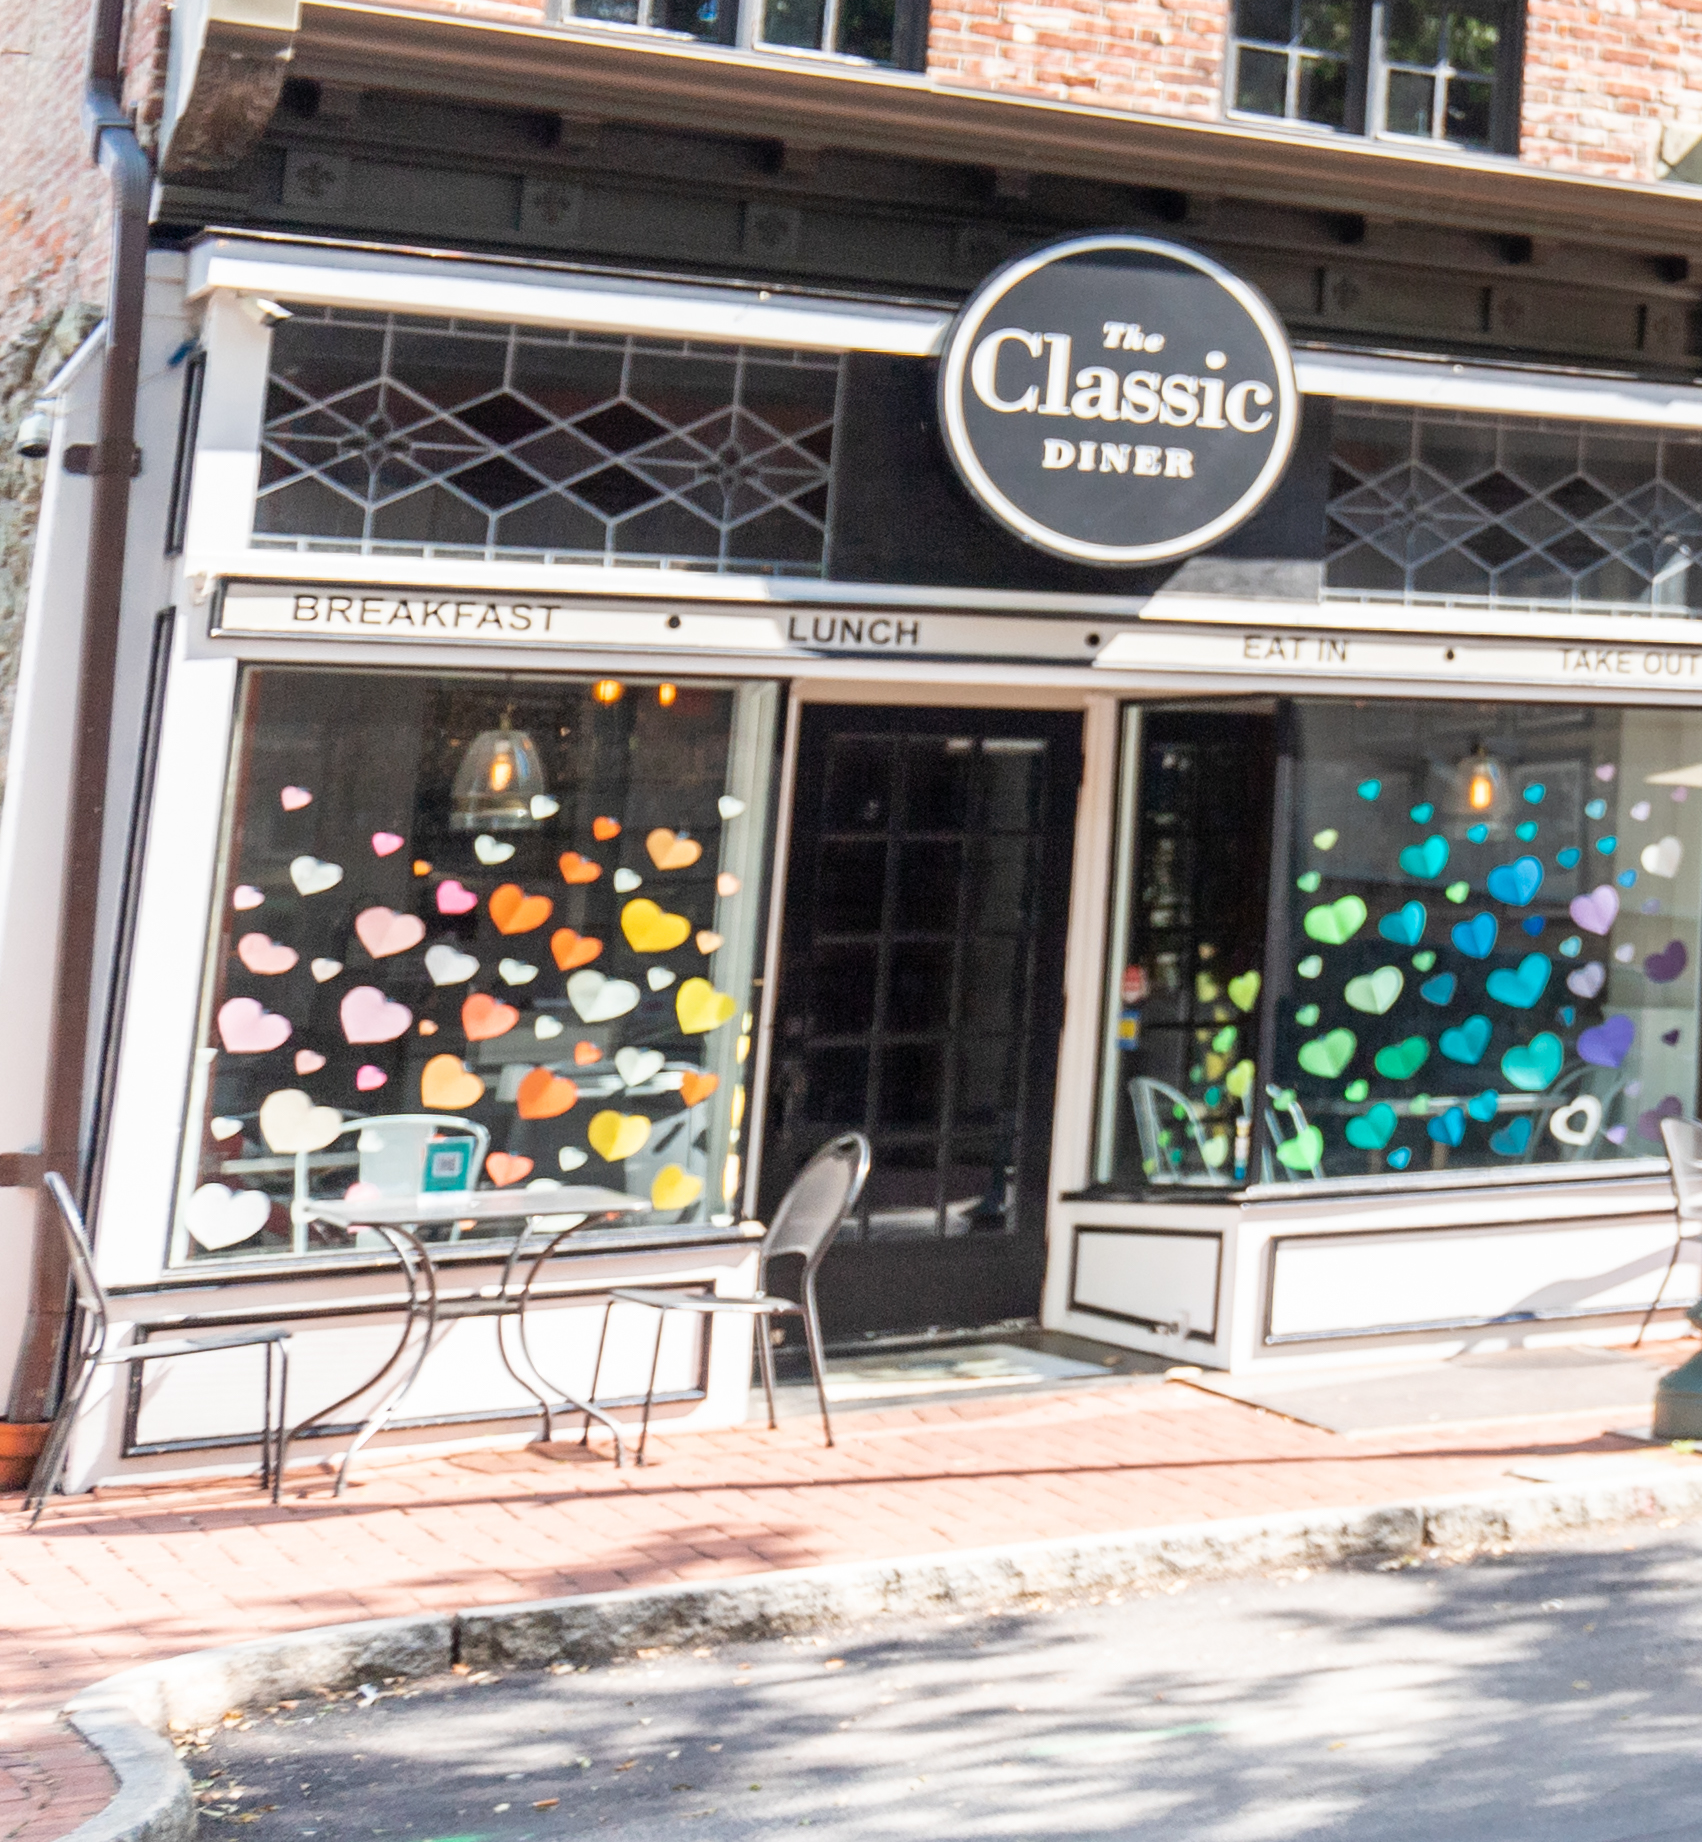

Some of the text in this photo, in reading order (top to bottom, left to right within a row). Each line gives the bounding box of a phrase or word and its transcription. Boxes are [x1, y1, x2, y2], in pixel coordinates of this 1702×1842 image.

[1103, 321, 1165, 353] The
[971, 327, 1274, 433] Classic
[1042, 438, 1195, 479] DINER
[293, 594, 1700, 676] BREAKFAST LUNCH EAT IN TAKE OUT
